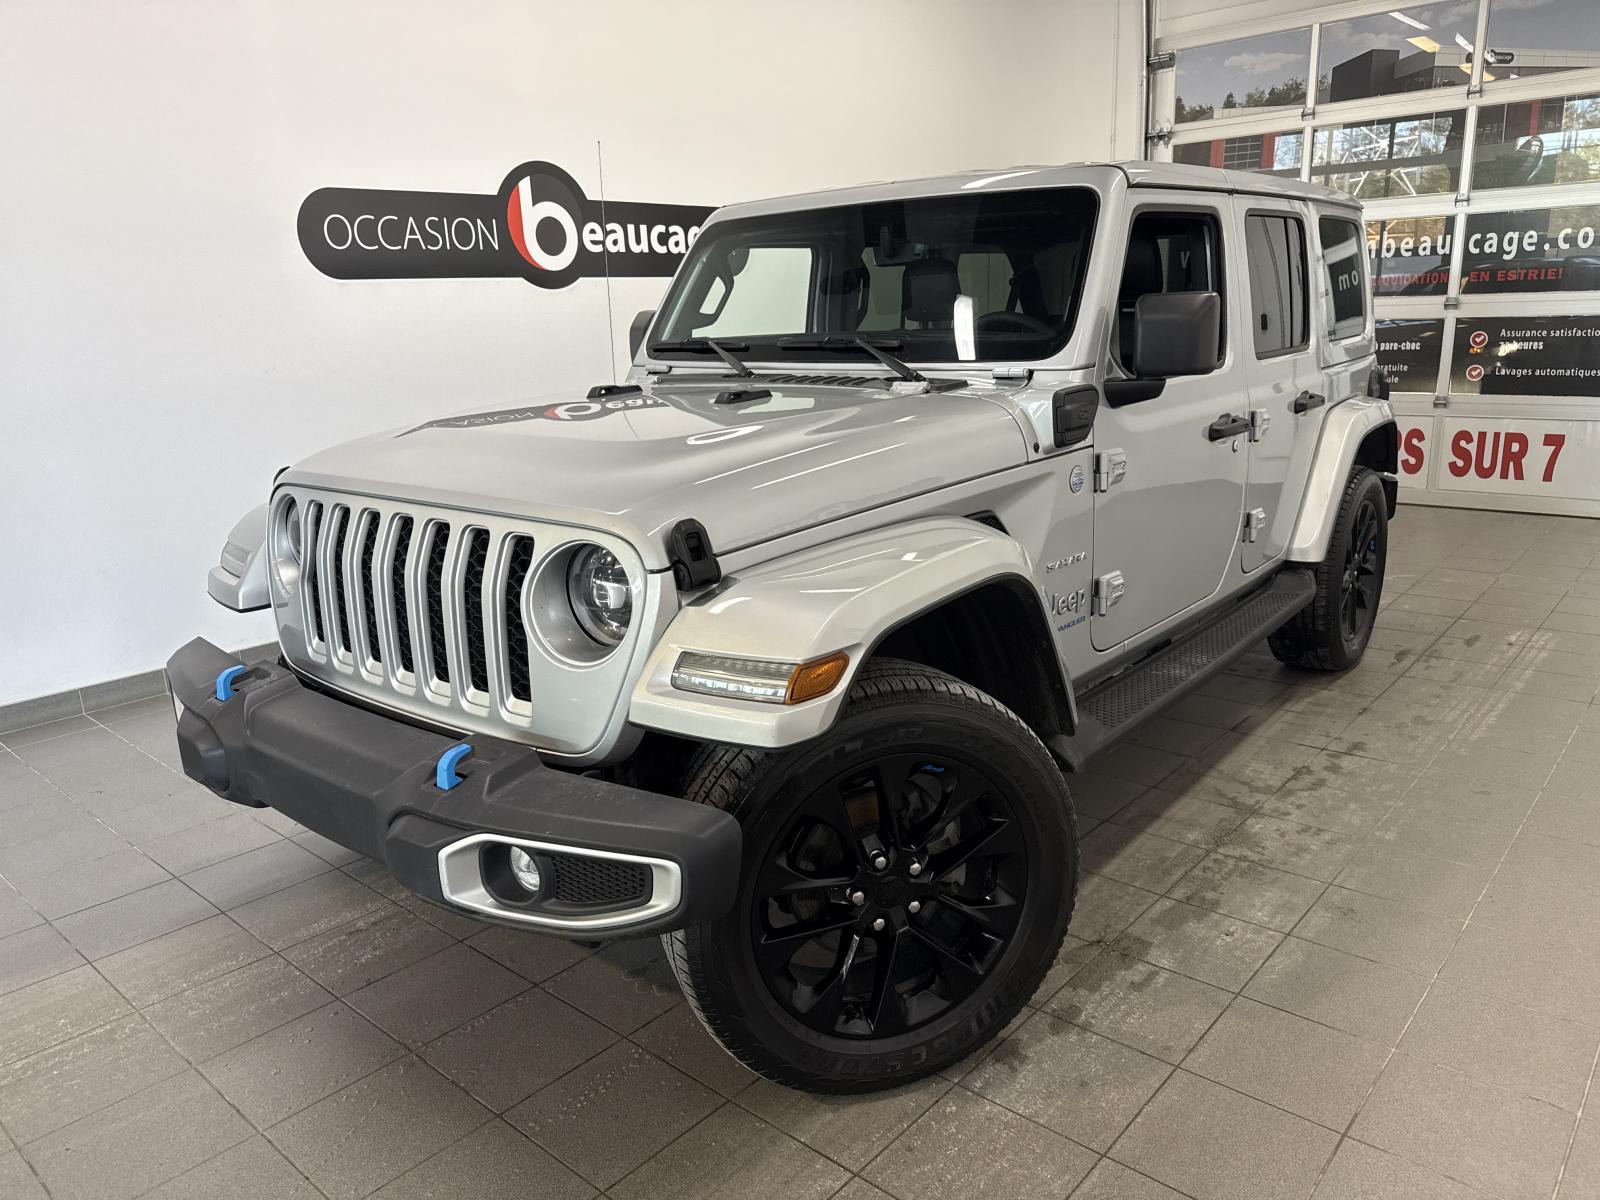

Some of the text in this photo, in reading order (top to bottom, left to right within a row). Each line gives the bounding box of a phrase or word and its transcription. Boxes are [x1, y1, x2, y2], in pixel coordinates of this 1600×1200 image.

[322, 212, 500, 252] OCCASION
[1469, 270, 1490, 283] EN
[1497, 267, 1564, 281] ESTRIE!
[1500, 328, 1548, 338] Assurance
[1380, 341, 1421, 351] pare-choc
[1495, 366, 1533, 378] Lavages
[1397, 427, 1567, 483] S SUR 7
[1051, 588, 1086, 616] Jeep
